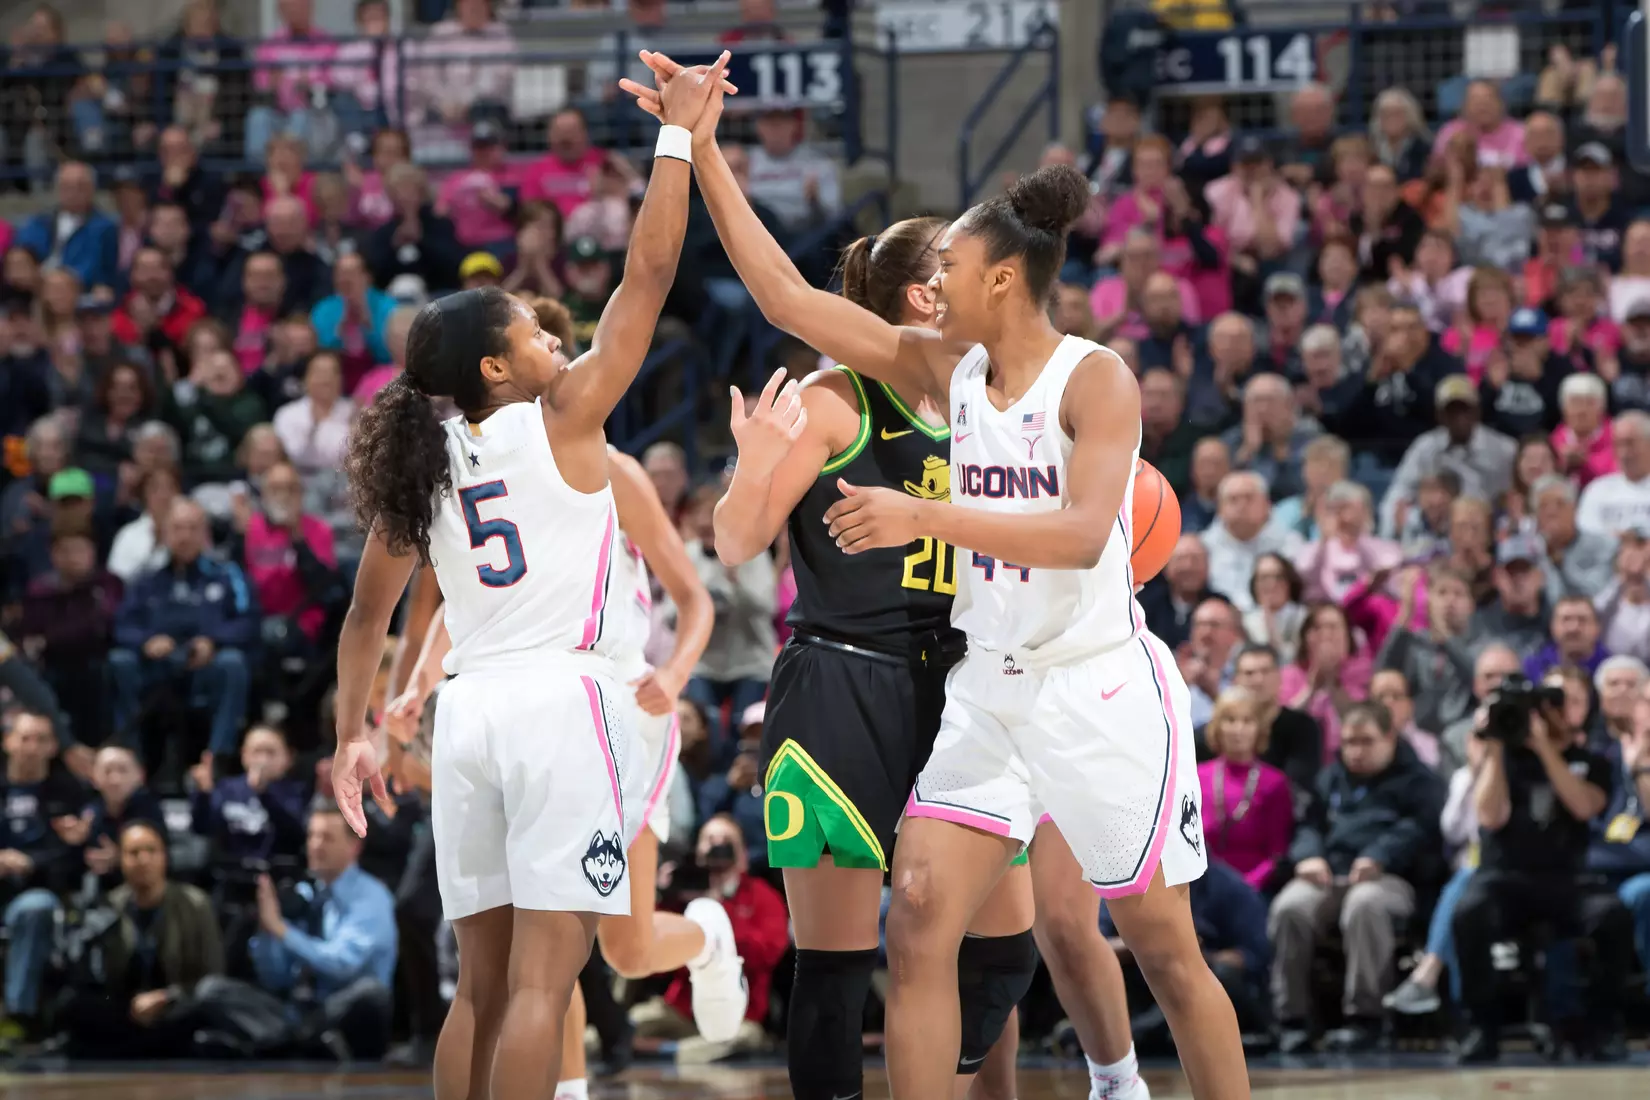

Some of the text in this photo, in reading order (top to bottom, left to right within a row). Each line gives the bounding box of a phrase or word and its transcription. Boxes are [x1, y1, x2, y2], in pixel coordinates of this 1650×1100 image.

[750, 53, 841, 101] 113
[1217, 33, 1316, 87] 114
[956, 462, 1060, 499] UCONN
[458, 479, 528, 588] 5
[764, 790, 805, 841] O
